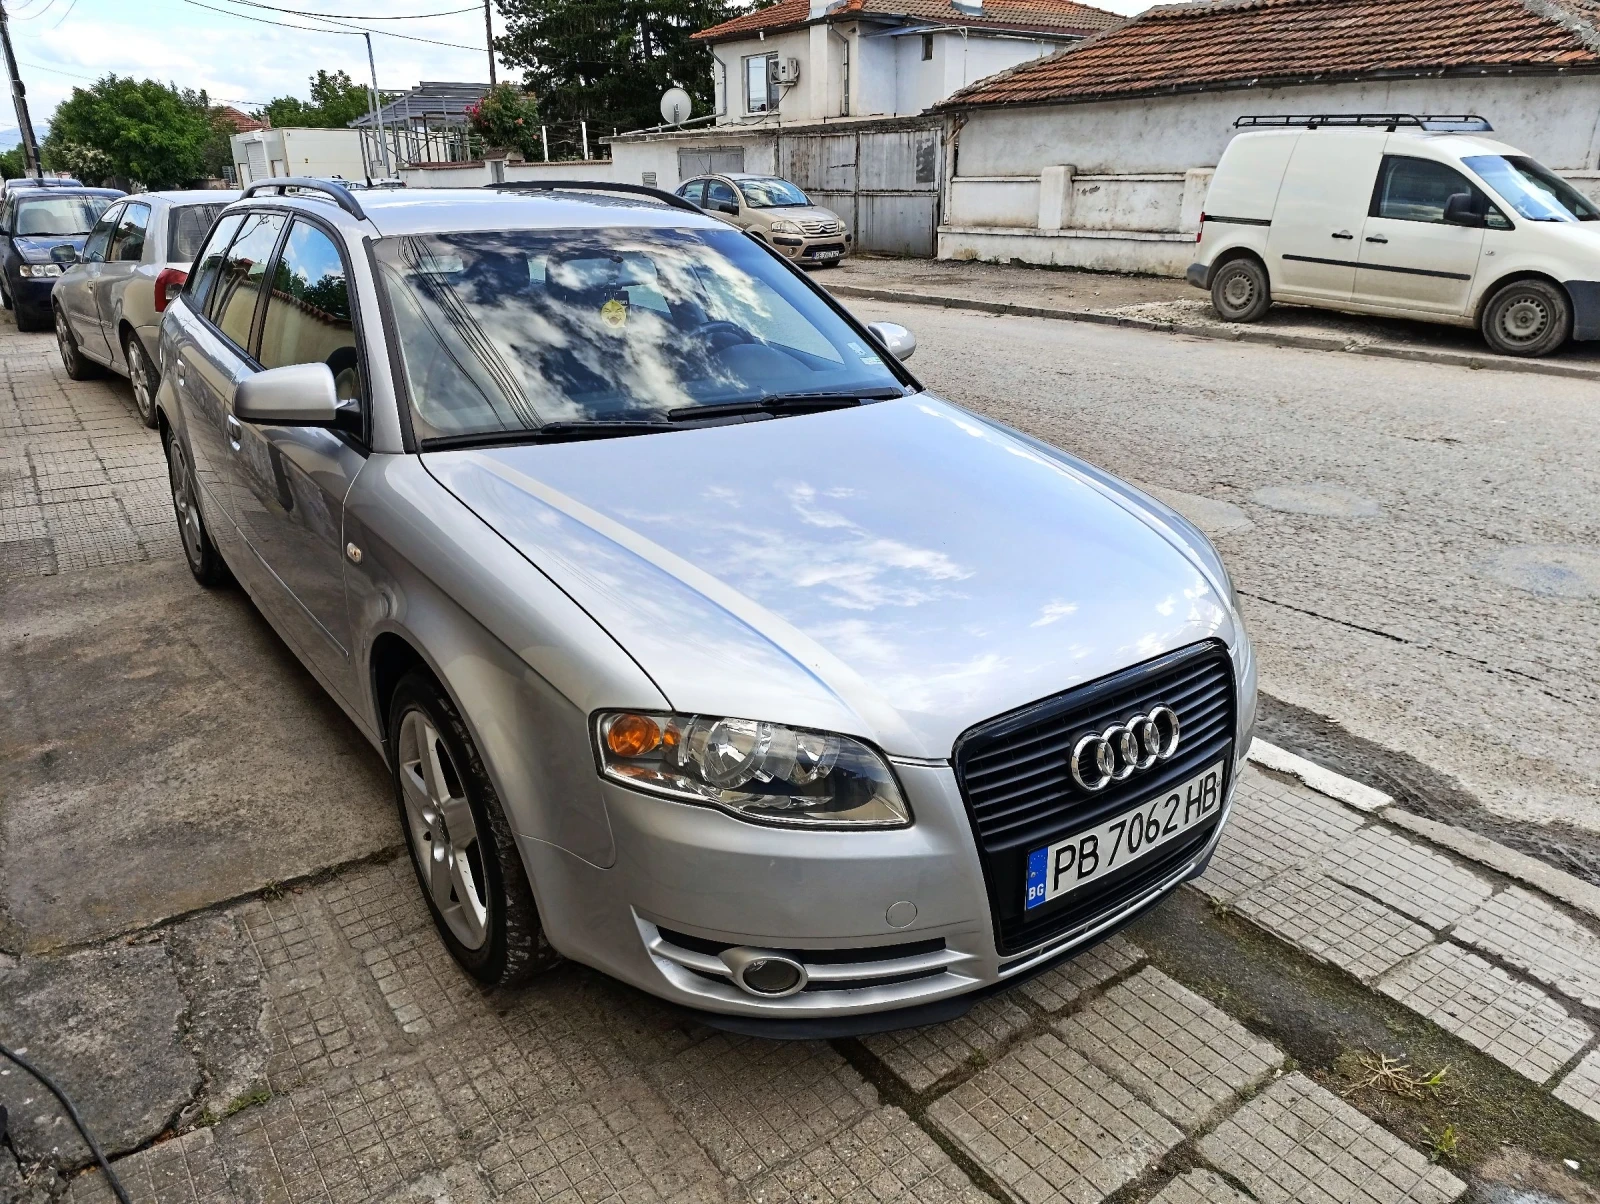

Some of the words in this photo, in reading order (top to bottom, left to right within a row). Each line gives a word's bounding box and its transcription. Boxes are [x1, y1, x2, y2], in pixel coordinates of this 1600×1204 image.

[1053, 835, 1099, 891] PB
[1107, 794, 1180, 867] 7062
[1184, 772, 1217, 824] HB
[1028, 883, 1044, 900] BG
